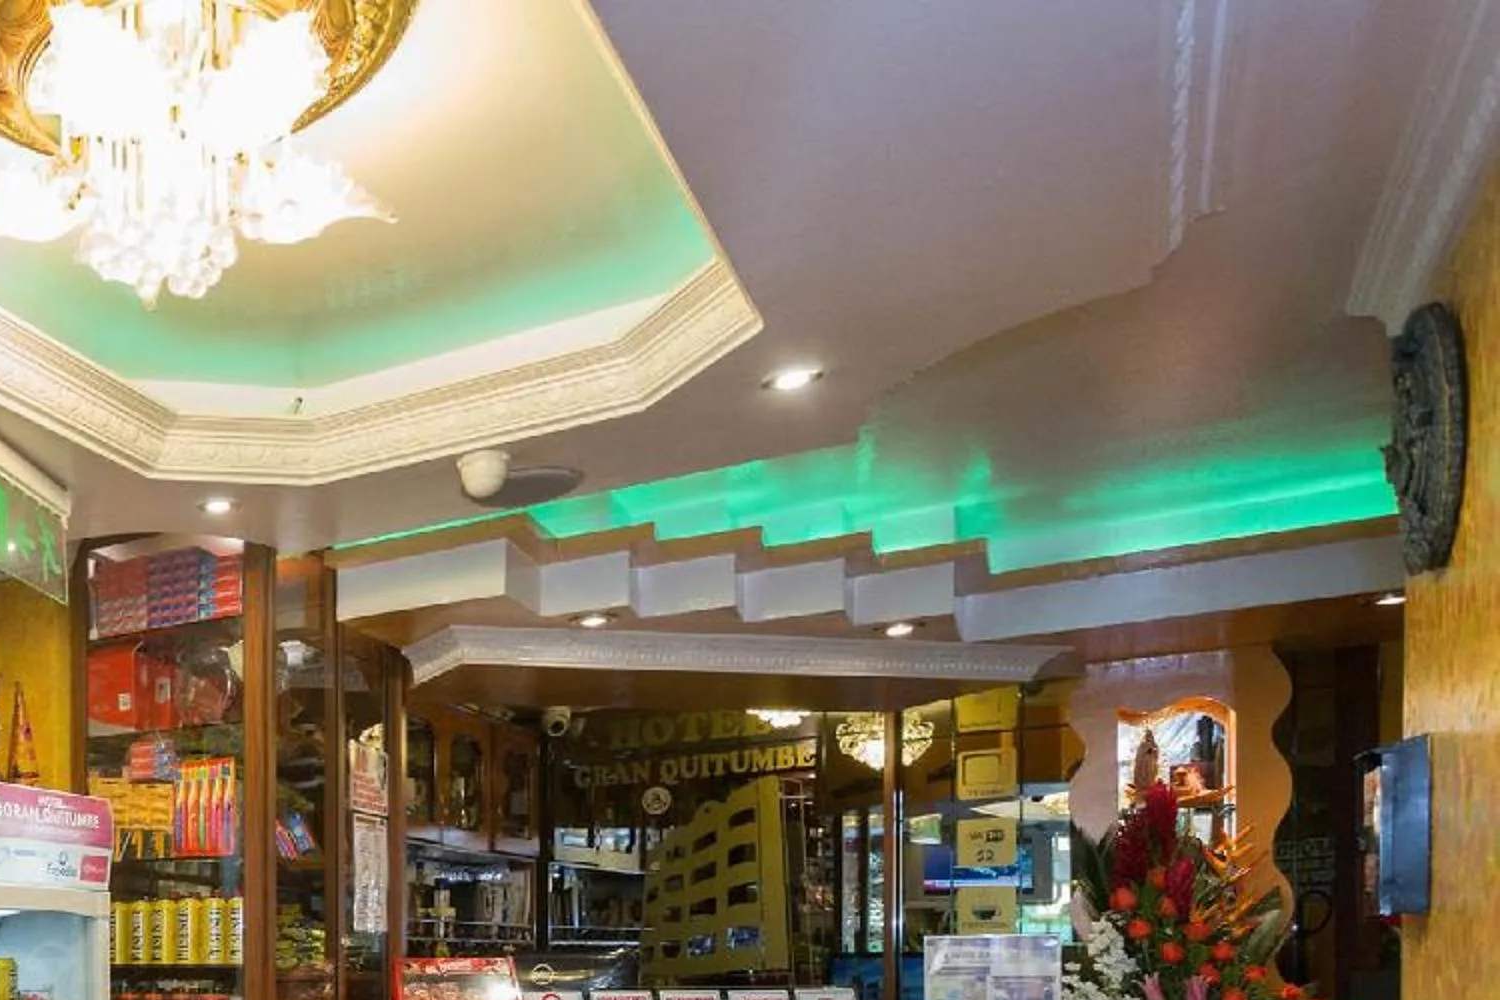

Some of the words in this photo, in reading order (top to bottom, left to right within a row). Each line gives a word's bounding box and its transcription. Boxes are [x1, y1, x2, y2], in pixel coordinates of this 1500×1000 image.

[610, 710, 772, 748] HOTEL
[573, 760, 650, 788] GRAN
[660, 740, 816, 785] QUITUMBE
